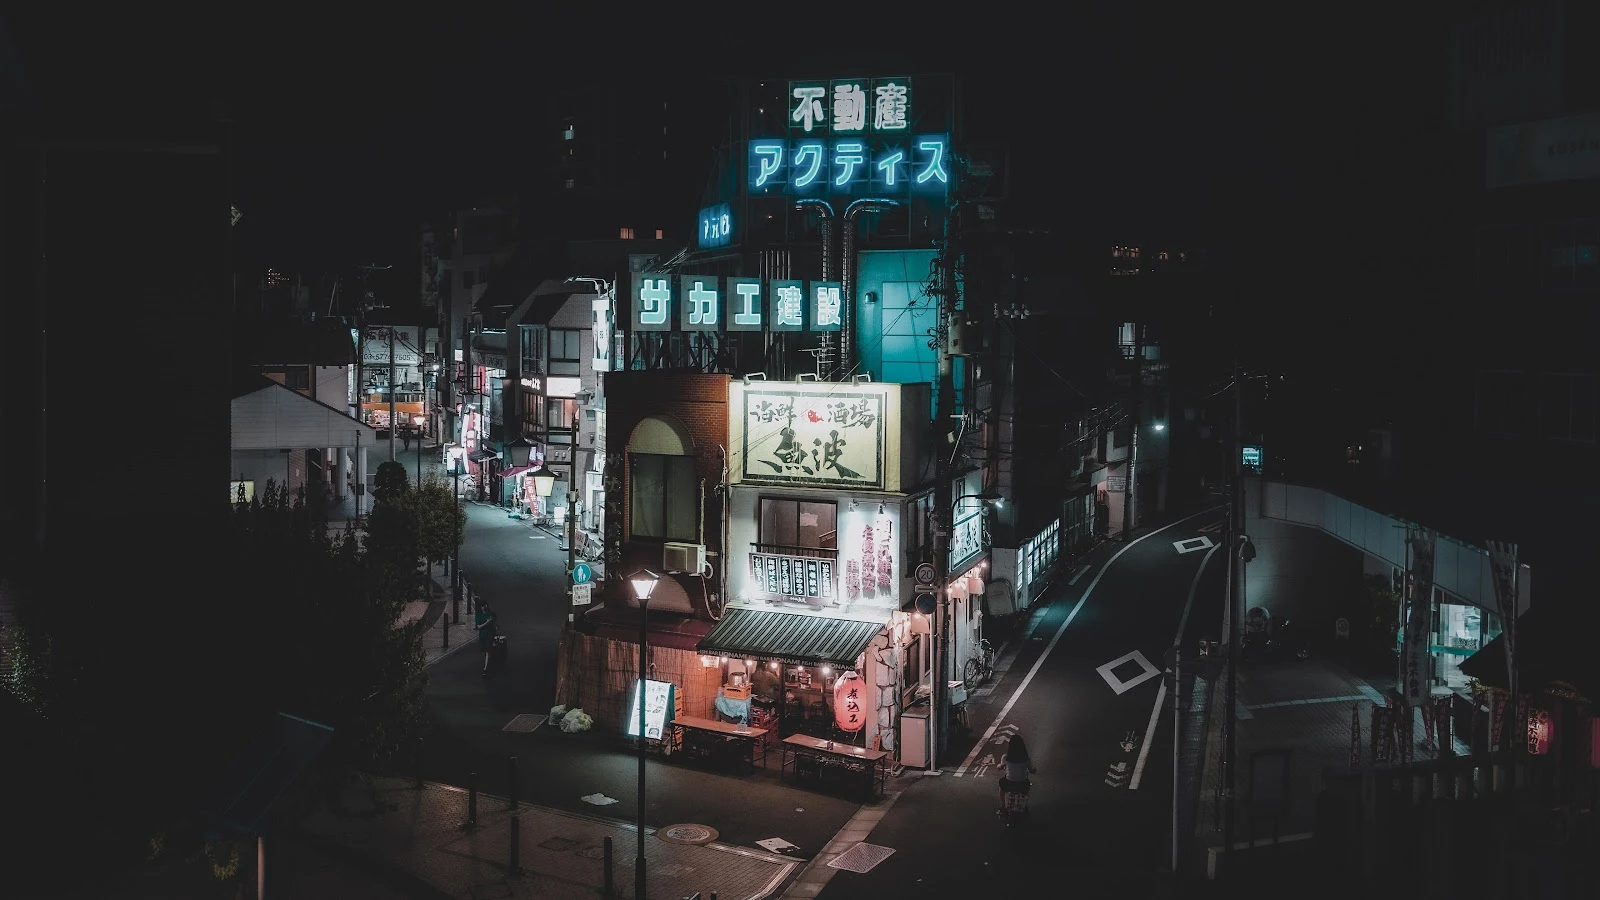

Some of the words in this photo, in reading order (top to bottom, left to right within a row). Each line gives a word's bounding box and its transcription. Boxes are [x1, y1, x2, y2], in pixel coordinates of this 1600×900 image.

[792, 82, 907, 131] 不動産
[754, 141, 947, 187] アクティス
[640, 279, 842, 326] サカエ建設
[750, 397, 796, 428] 海鮮
[827, 398, 875, 429] 酒場
[757, 426, 866, 479] 魚波
[920, 569, 933, 580] 20
[719, 651, 748, 660] UONAMI
[770, 657, 800, 666] UONAMI
